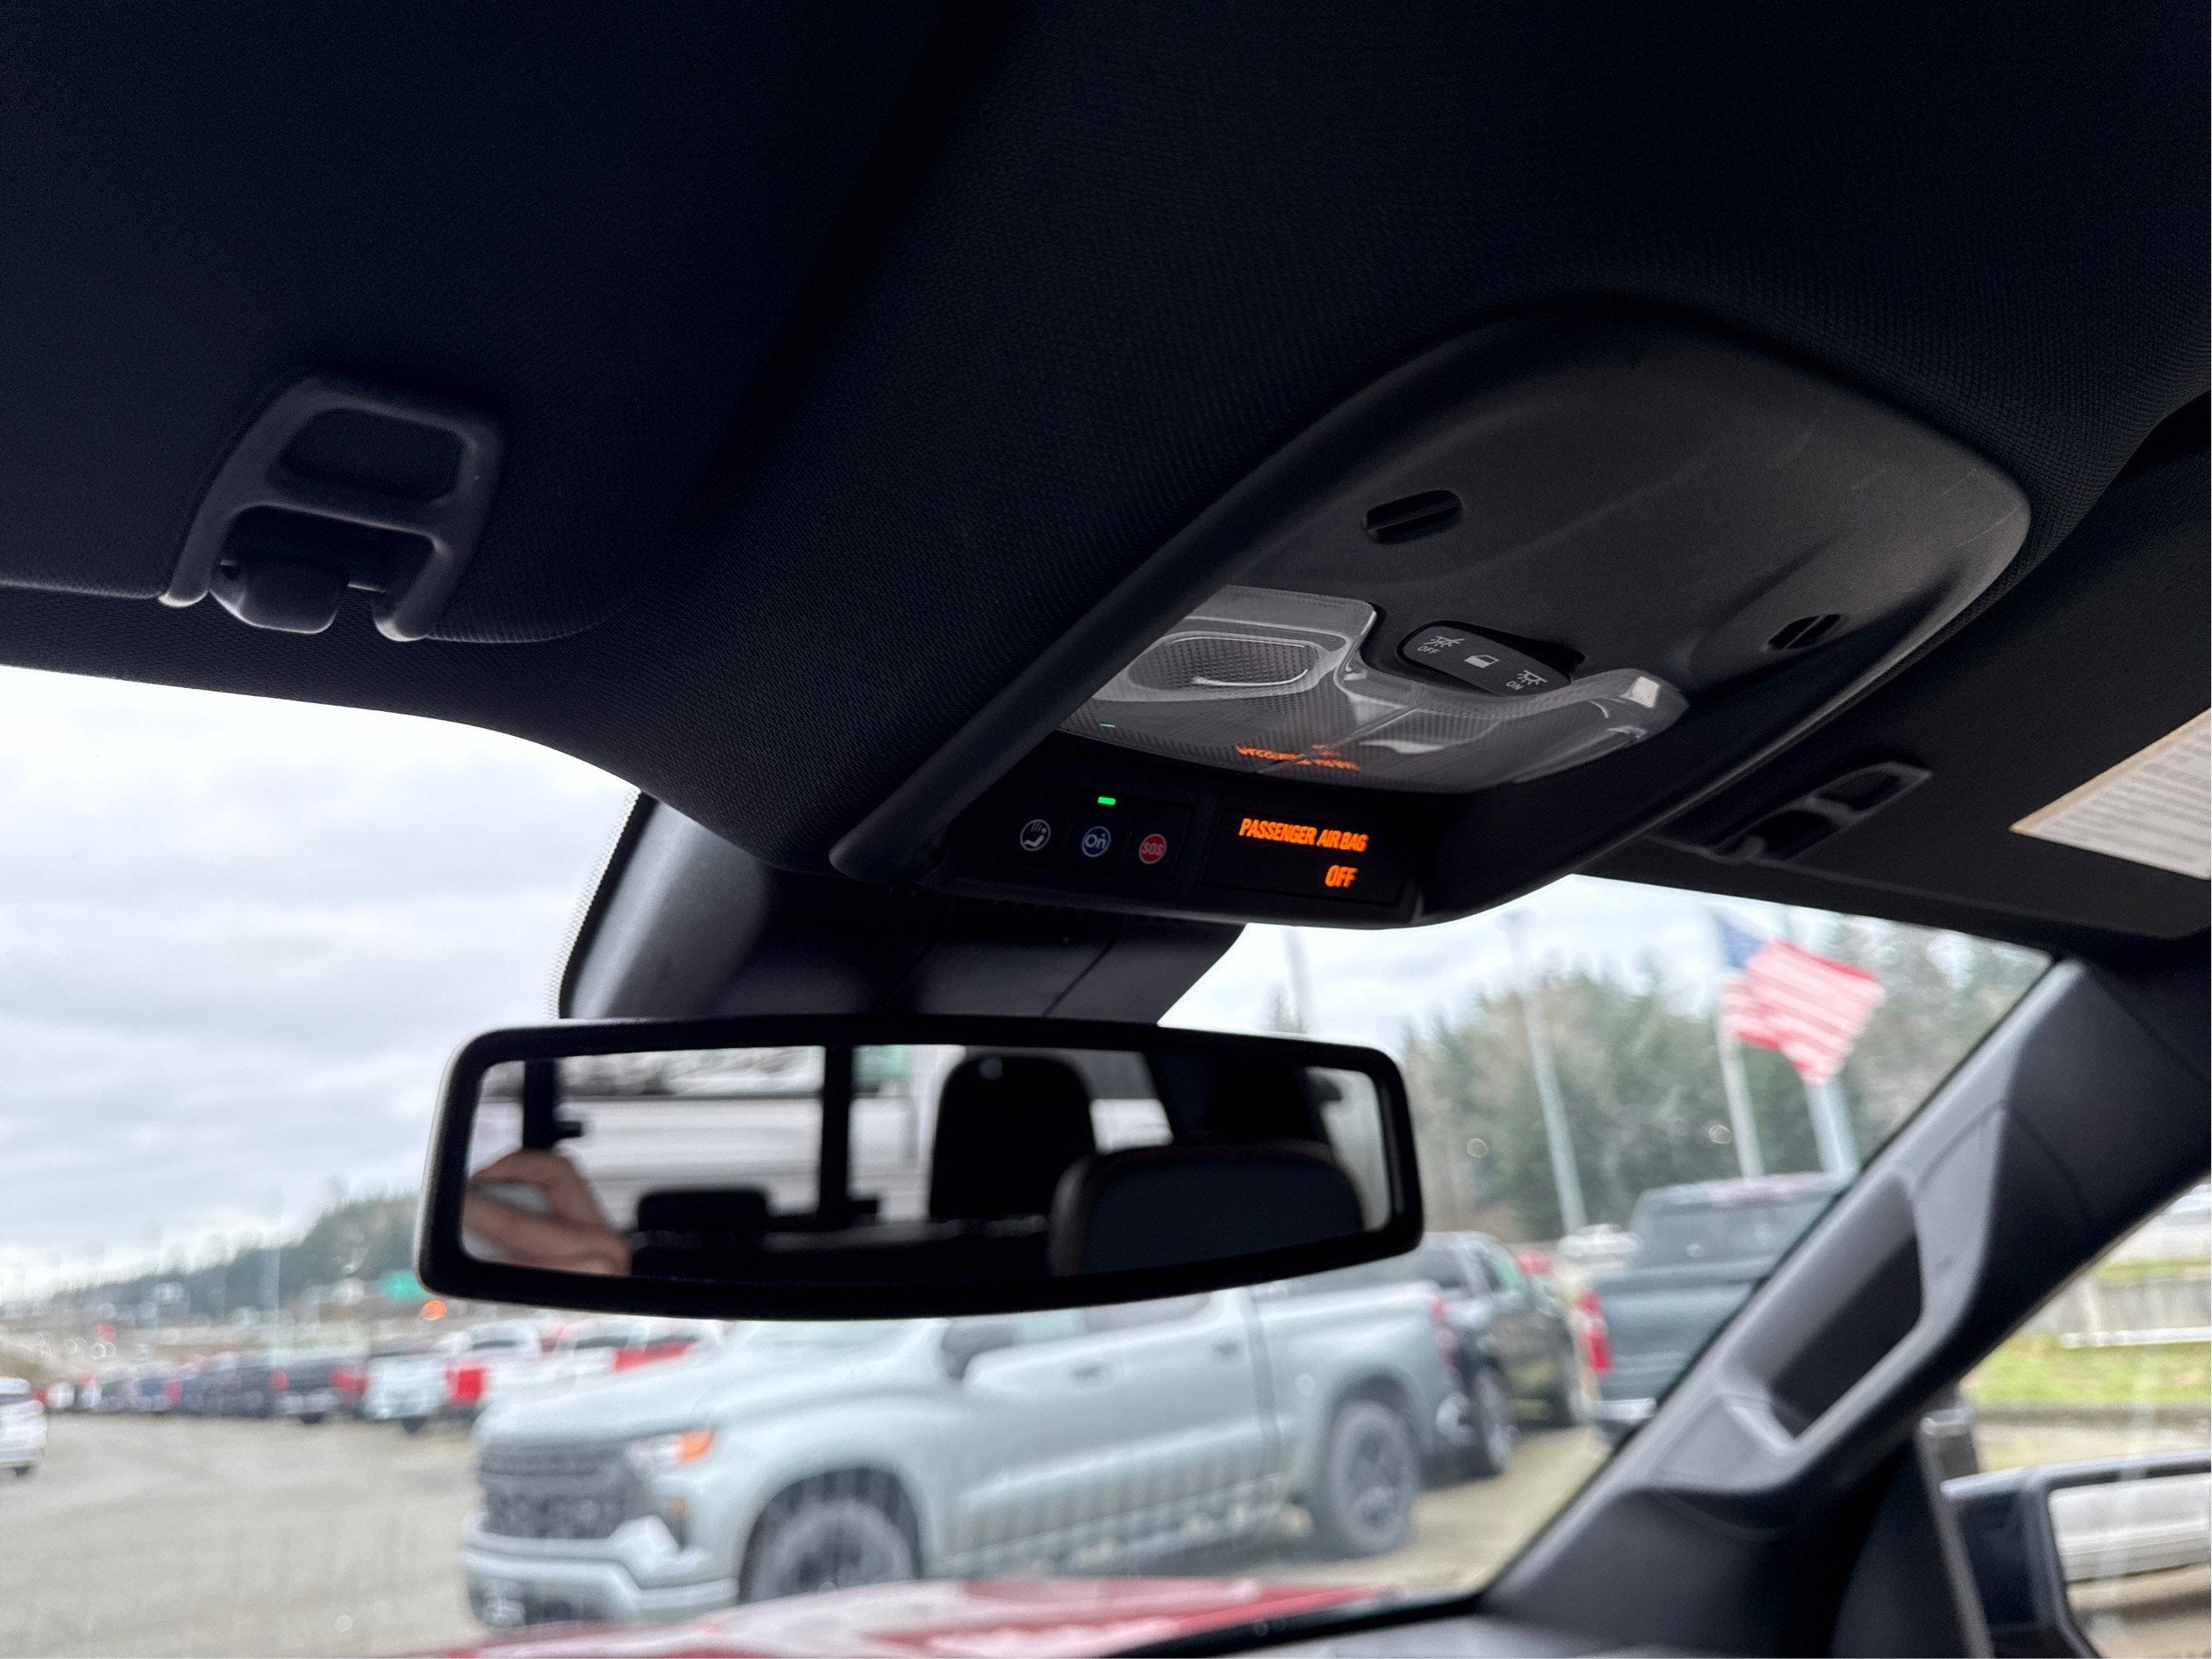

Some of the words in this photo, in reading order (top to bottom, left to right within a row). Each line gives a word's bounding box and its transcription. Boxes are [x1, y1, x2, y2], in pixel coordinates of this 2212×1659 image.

[1417, 646, 1440, 654] OFF
[1505, 680, 1524, 691] ON
[1239, 818, 1317, 846] PASSENGER
[1142, 841, 1164, 857] SOS
[1325, 865, 1358, 888] OFF
